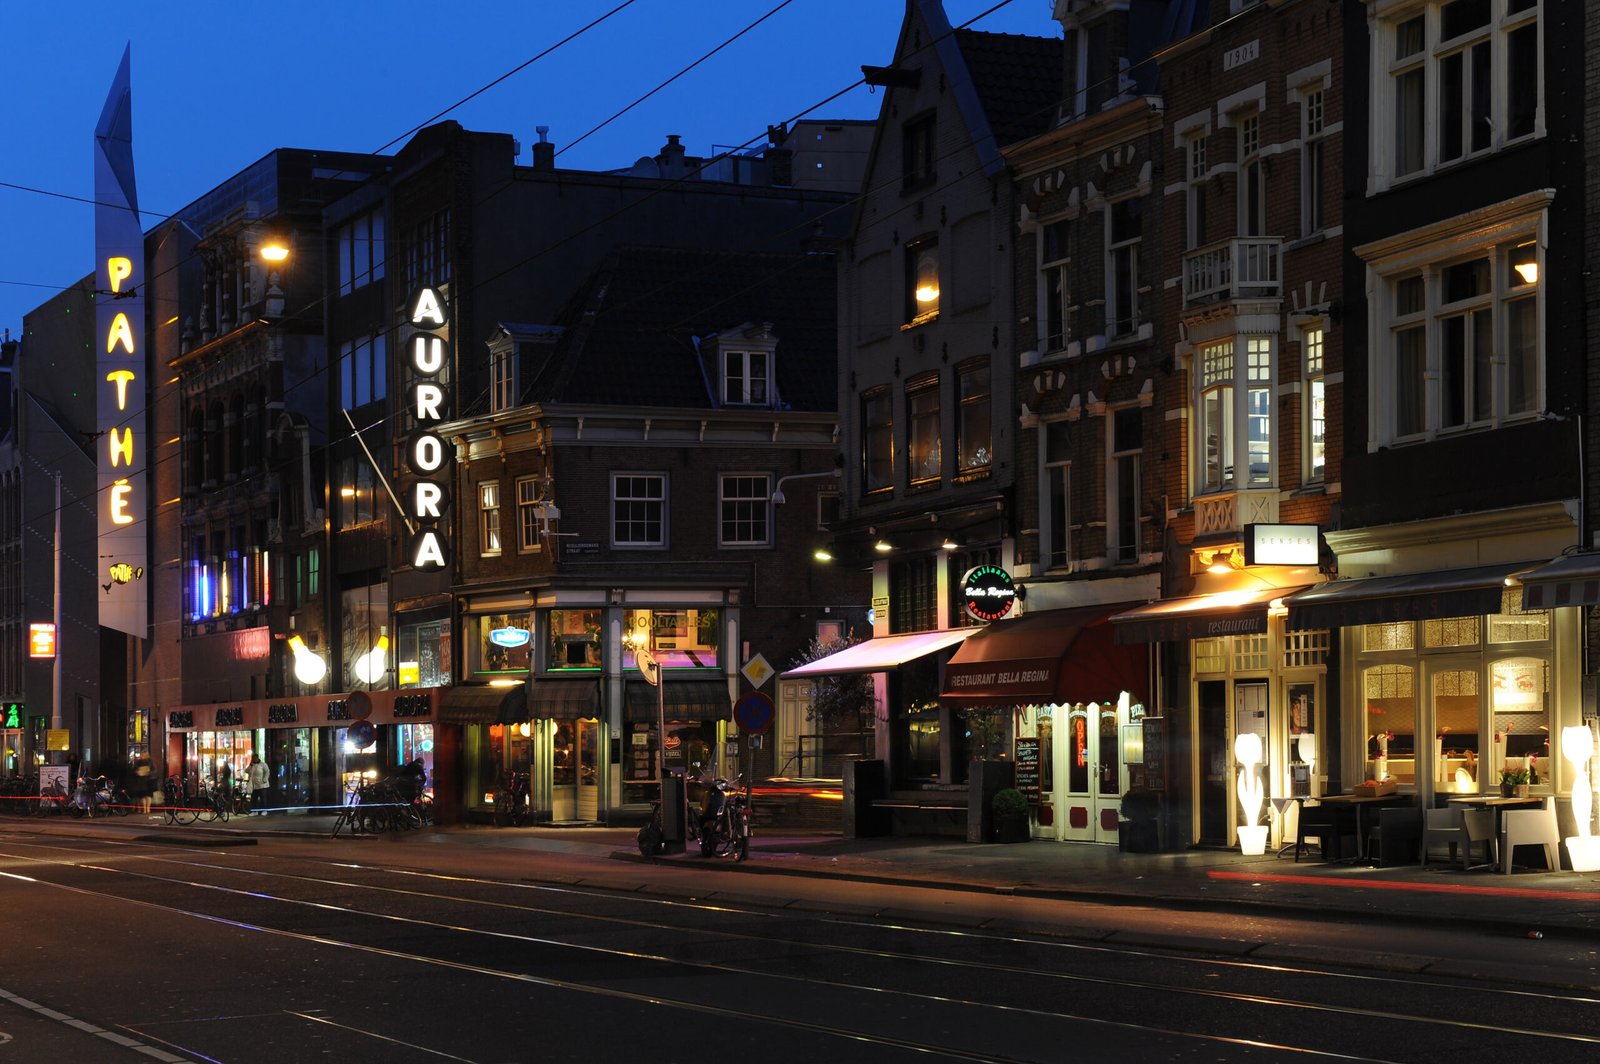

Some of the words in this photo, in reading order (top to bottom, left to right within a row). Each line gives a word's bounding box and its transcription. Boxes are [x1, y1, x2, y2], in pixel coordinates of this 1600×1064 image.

[1229, 44, 1255, 67] 1904
[107, 257, 135, 524] PATHÉ
[412, 288, 446, 567] AURORA
[969, 601, 1013, 620] Restaurant
[629, 615, 711, 631] POOLTABLES
[1208, 616, 1260, 633] restaurant
[952, 673, 996, 686] RESTAURANT
[997, 671, 1019, 684] BELLA
[1021, 670, 1050, 682] REGINA
[1076, 720, 1085, 767] OPEN
